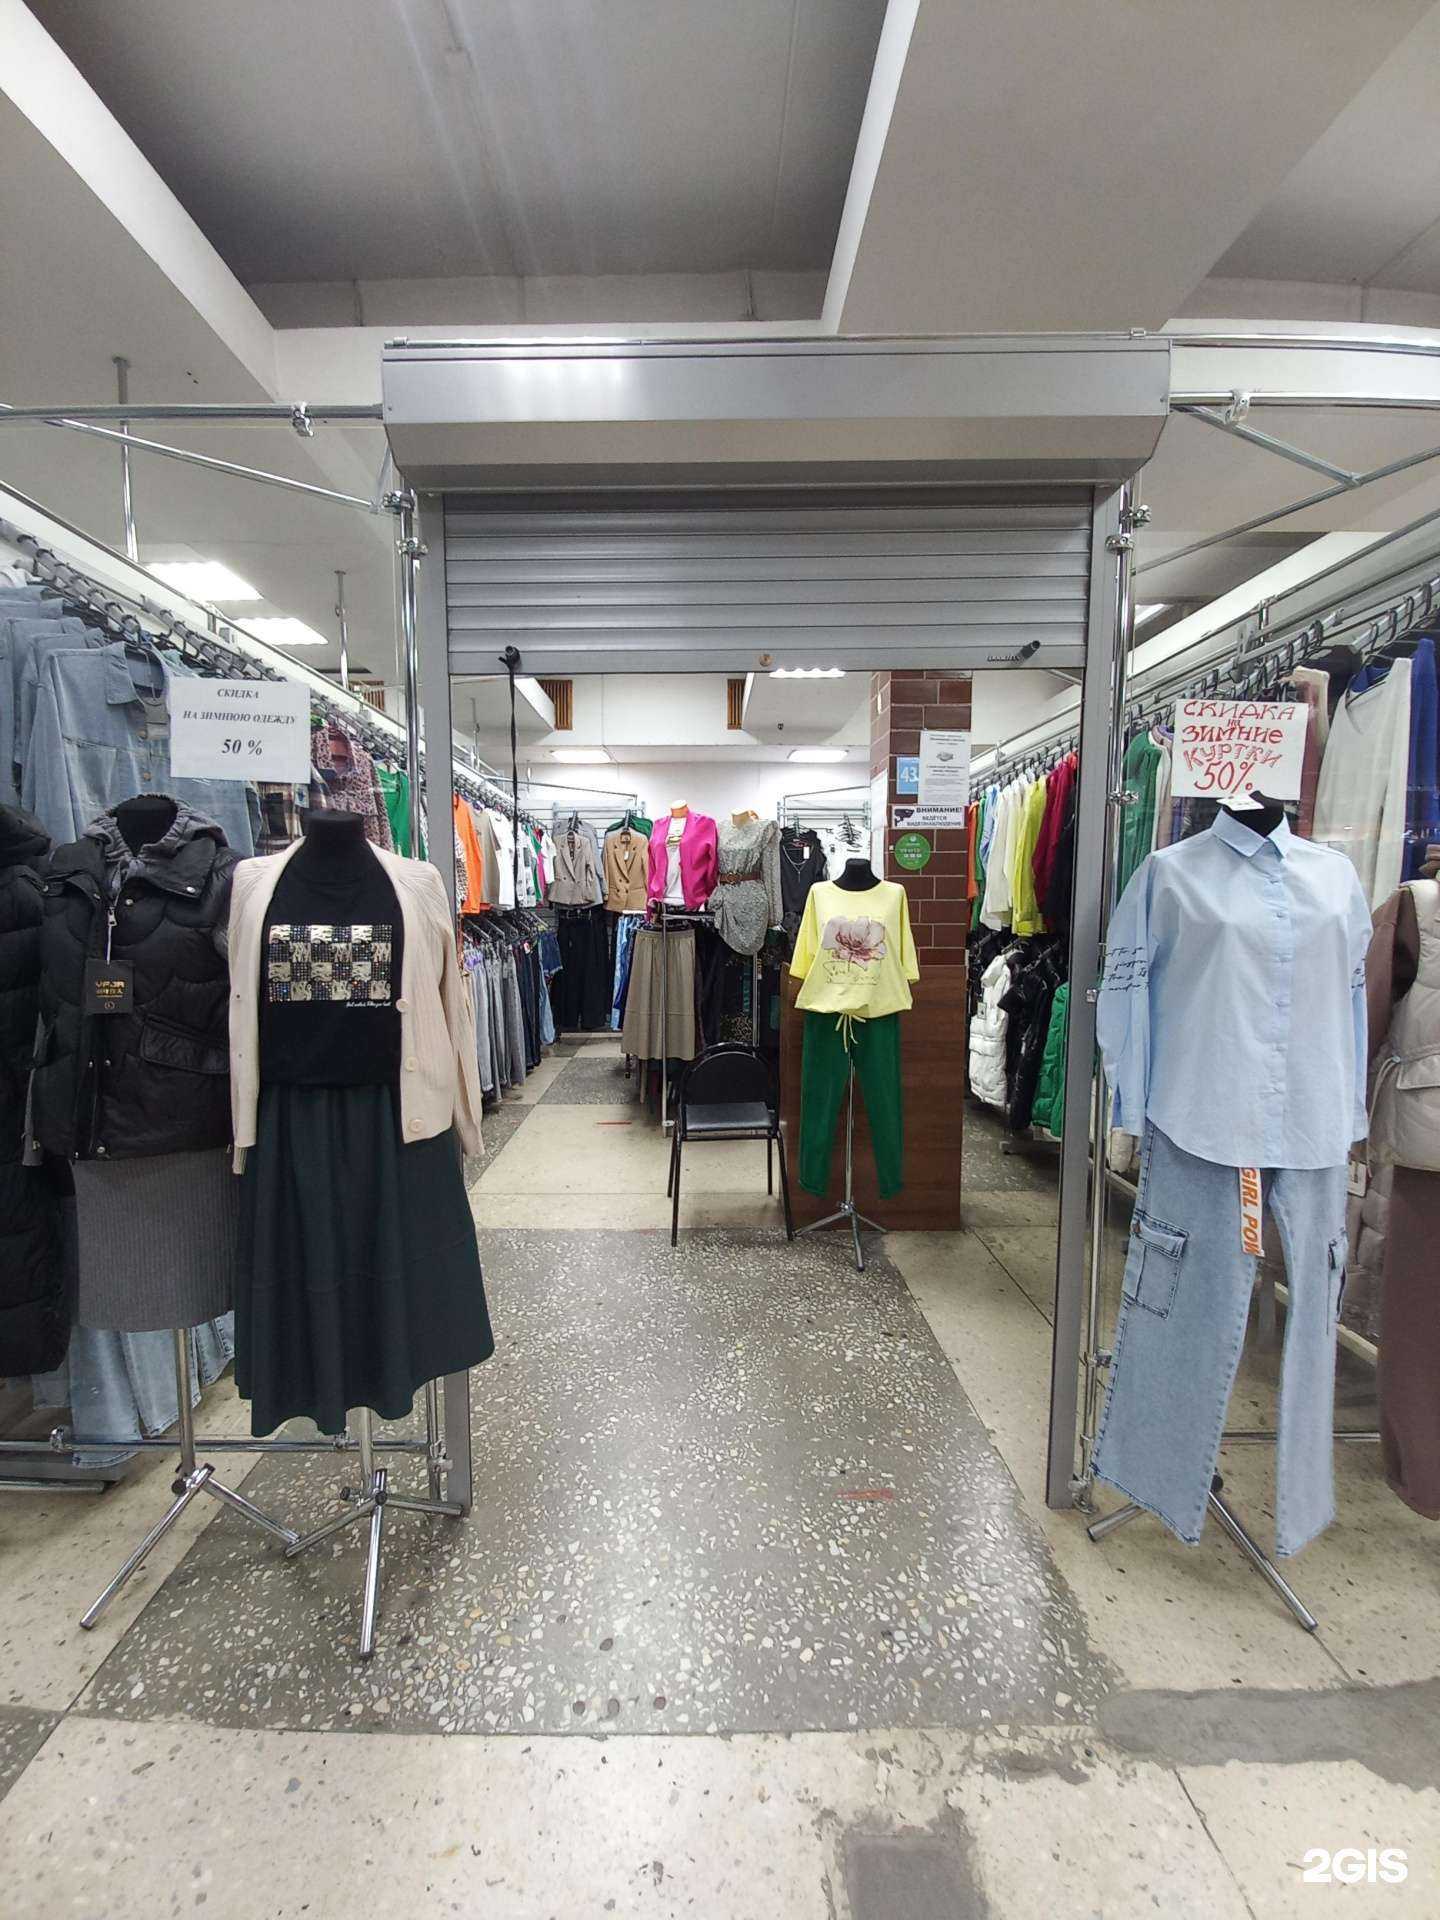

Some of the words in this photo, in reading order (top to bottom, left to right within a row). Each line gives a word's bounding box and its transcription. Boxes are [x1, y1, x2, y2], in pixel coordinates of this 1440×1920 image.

[217, 688, 260, 699] СКИДКА
[183, 710, 198, 720] НА
[200, 711, 251, 722] ЗИМНЮЮ
[253, 714, 296, 725] ОДЕЖДУ
[1183, 700, 1296, 720] СКИДКА
[221, 739, 242, 754] 50
[247, 739, 263, 756] %
[1183, 743, 1283, 771] КУРТКИ
[1194, 761, 1255, 794] 50%
[1242, 1168, 1258, 1207] GIRL
